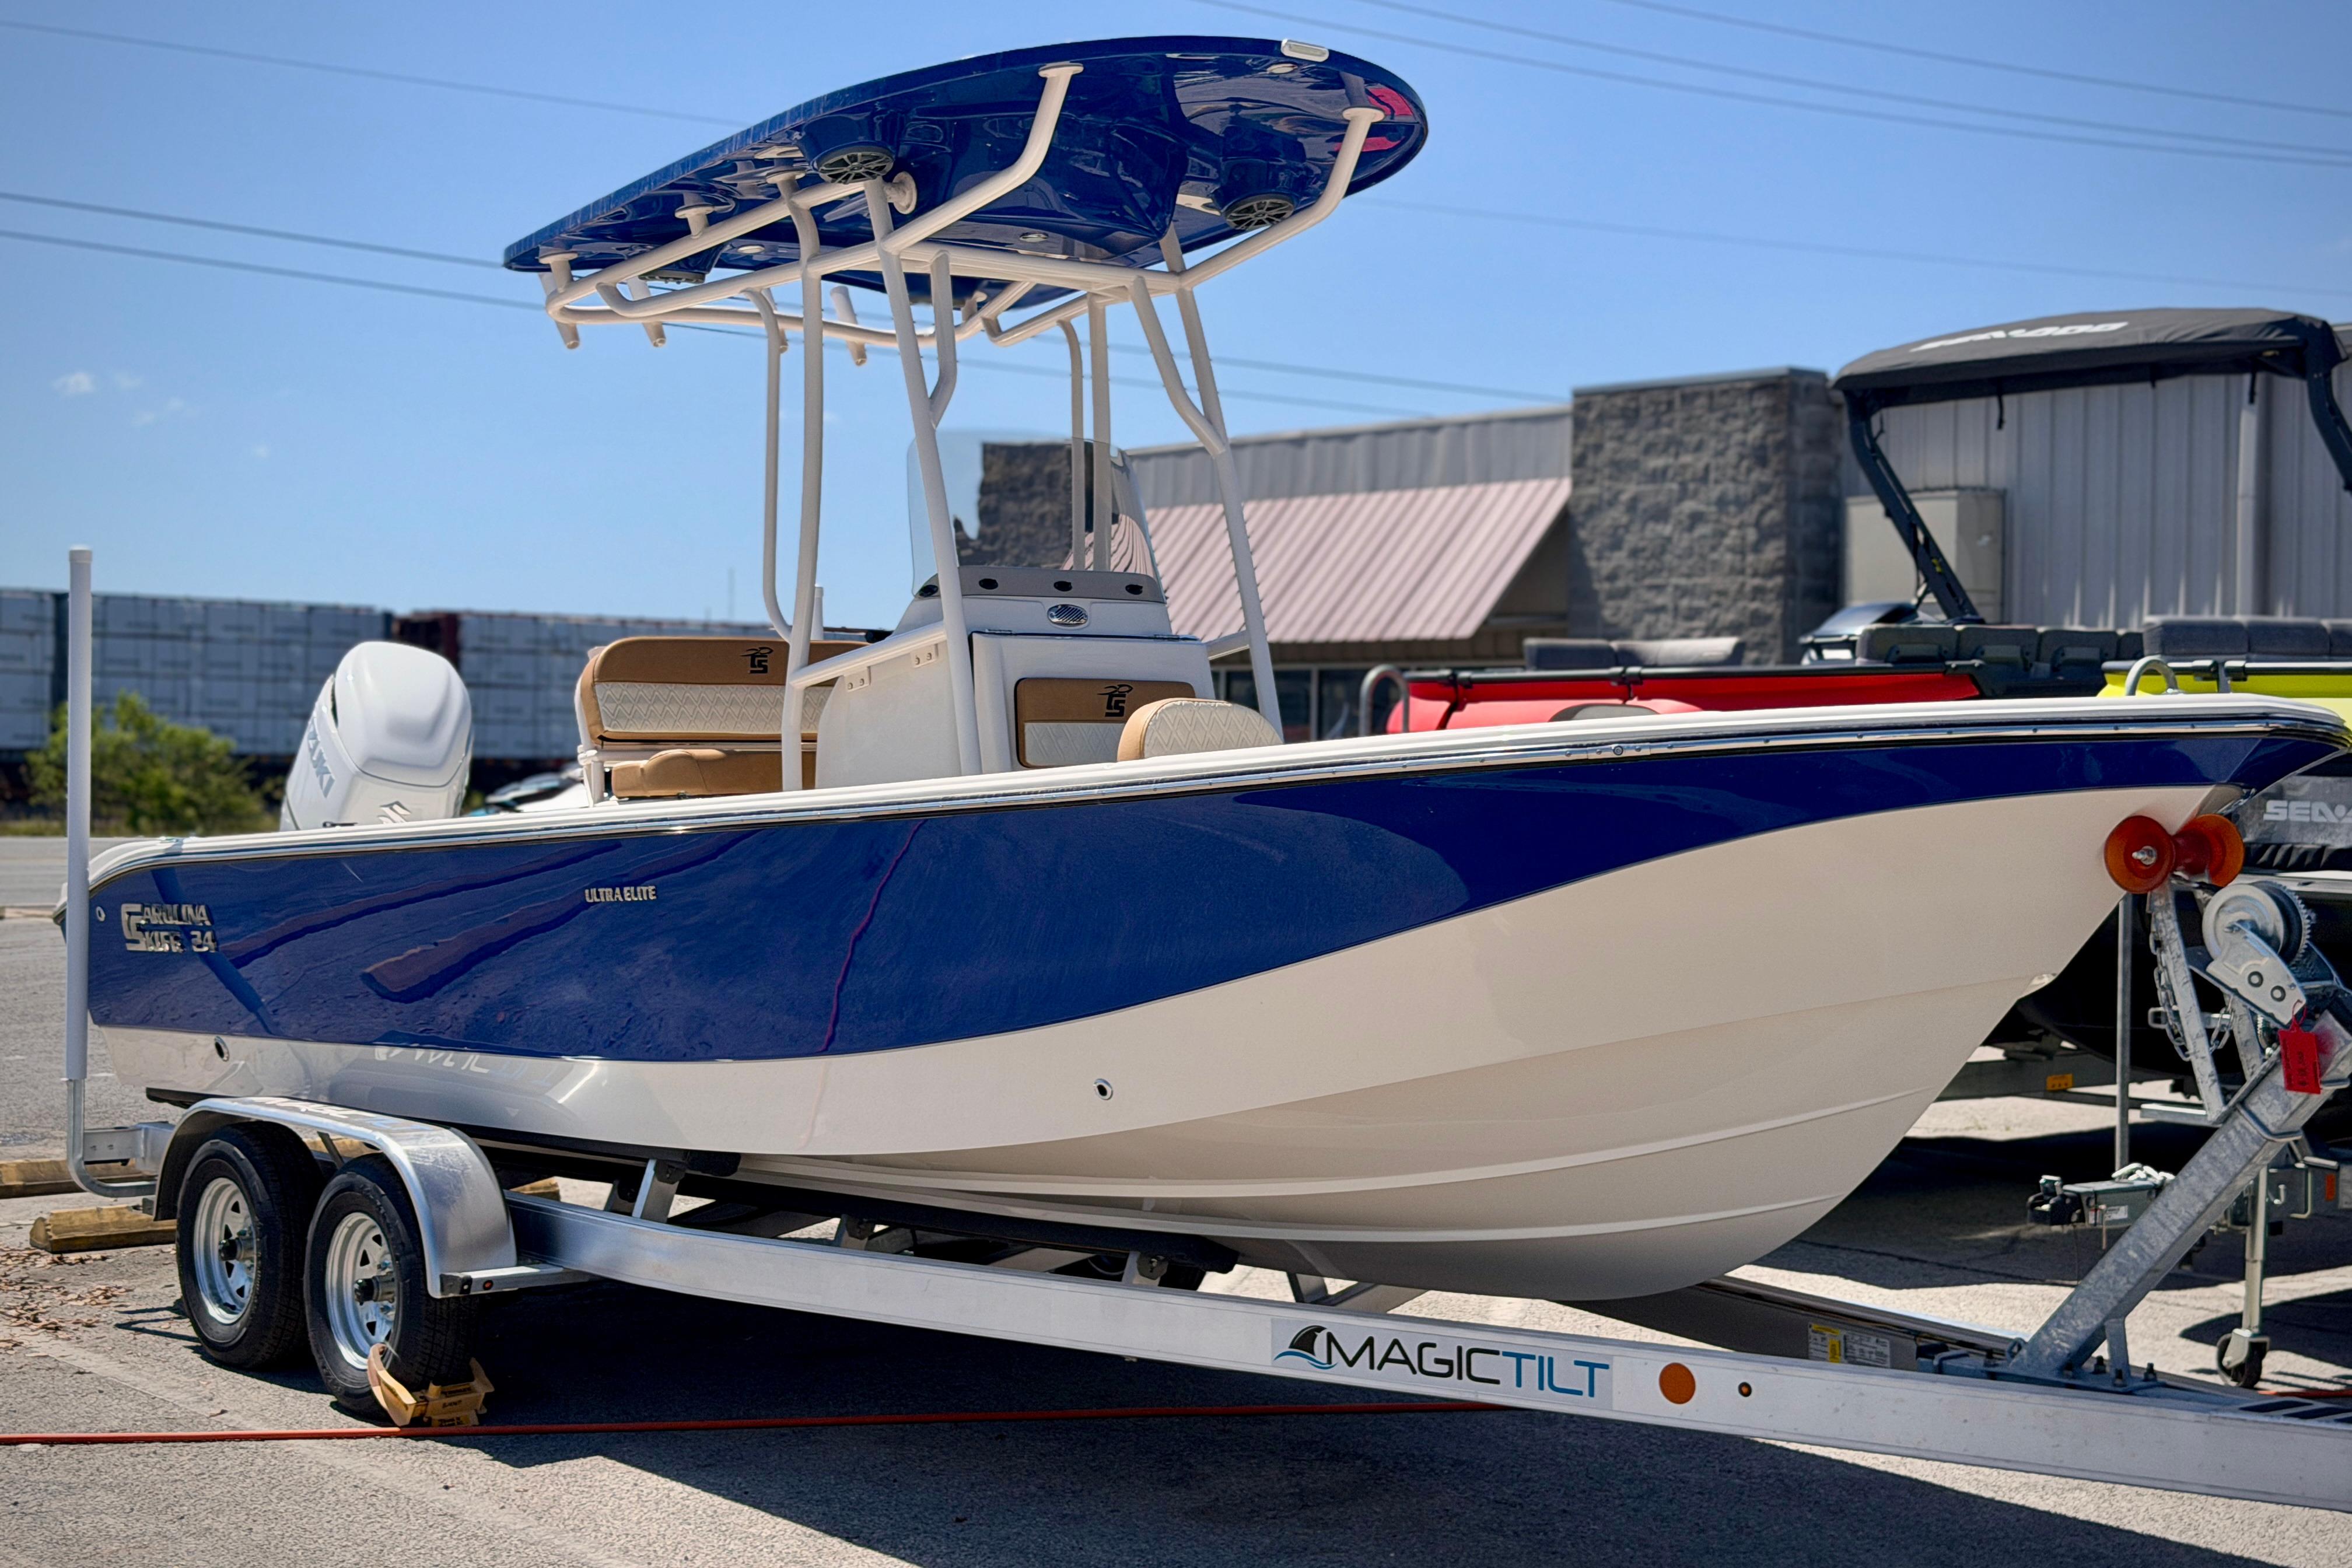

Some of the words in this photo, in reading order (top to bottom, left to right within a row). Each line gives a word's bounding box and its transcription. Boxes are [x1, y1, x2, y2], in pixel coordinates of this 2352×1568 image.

[584, 887, 624, 903] ULTRA
[623, 886, 657, 901] ELITE
[1325, 1331, 1610, 1398] MAGICTILT
